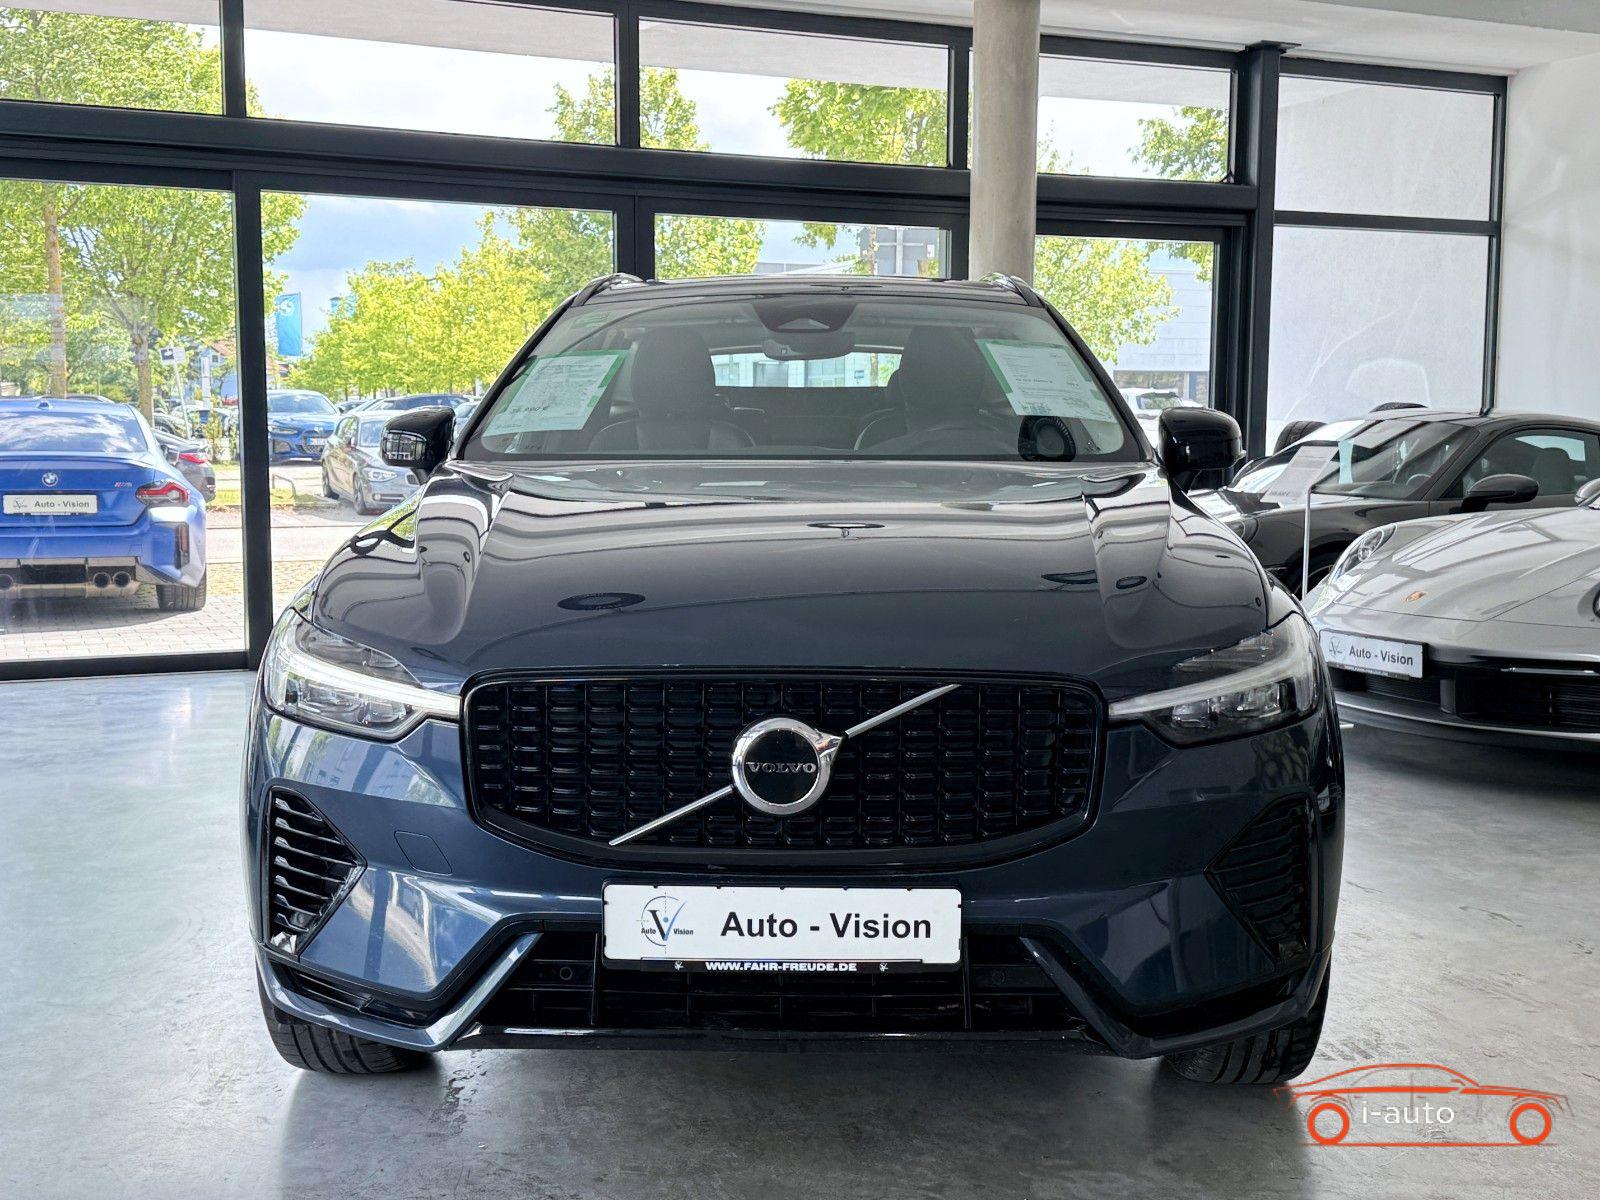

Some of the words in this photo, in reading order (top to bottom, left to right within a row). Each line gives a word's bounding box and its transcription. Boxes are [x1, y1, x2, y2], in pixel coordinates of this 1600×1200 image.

[34, 500, 55, 508] Auto
[62, 500, 90, 508] Vision
[1349, 645, 1372, 659] Auto
[1380, 650, 1414, 666] Vision
[746, 761, 817, 774] VOLVO
[720, 911, 798, 939] Auto
[829, 912, 932, 939] Vision
[673, 928, 694, 936] Vision
[705, 961, 858, 972] WWW.FAHR-FREUDE.DE
